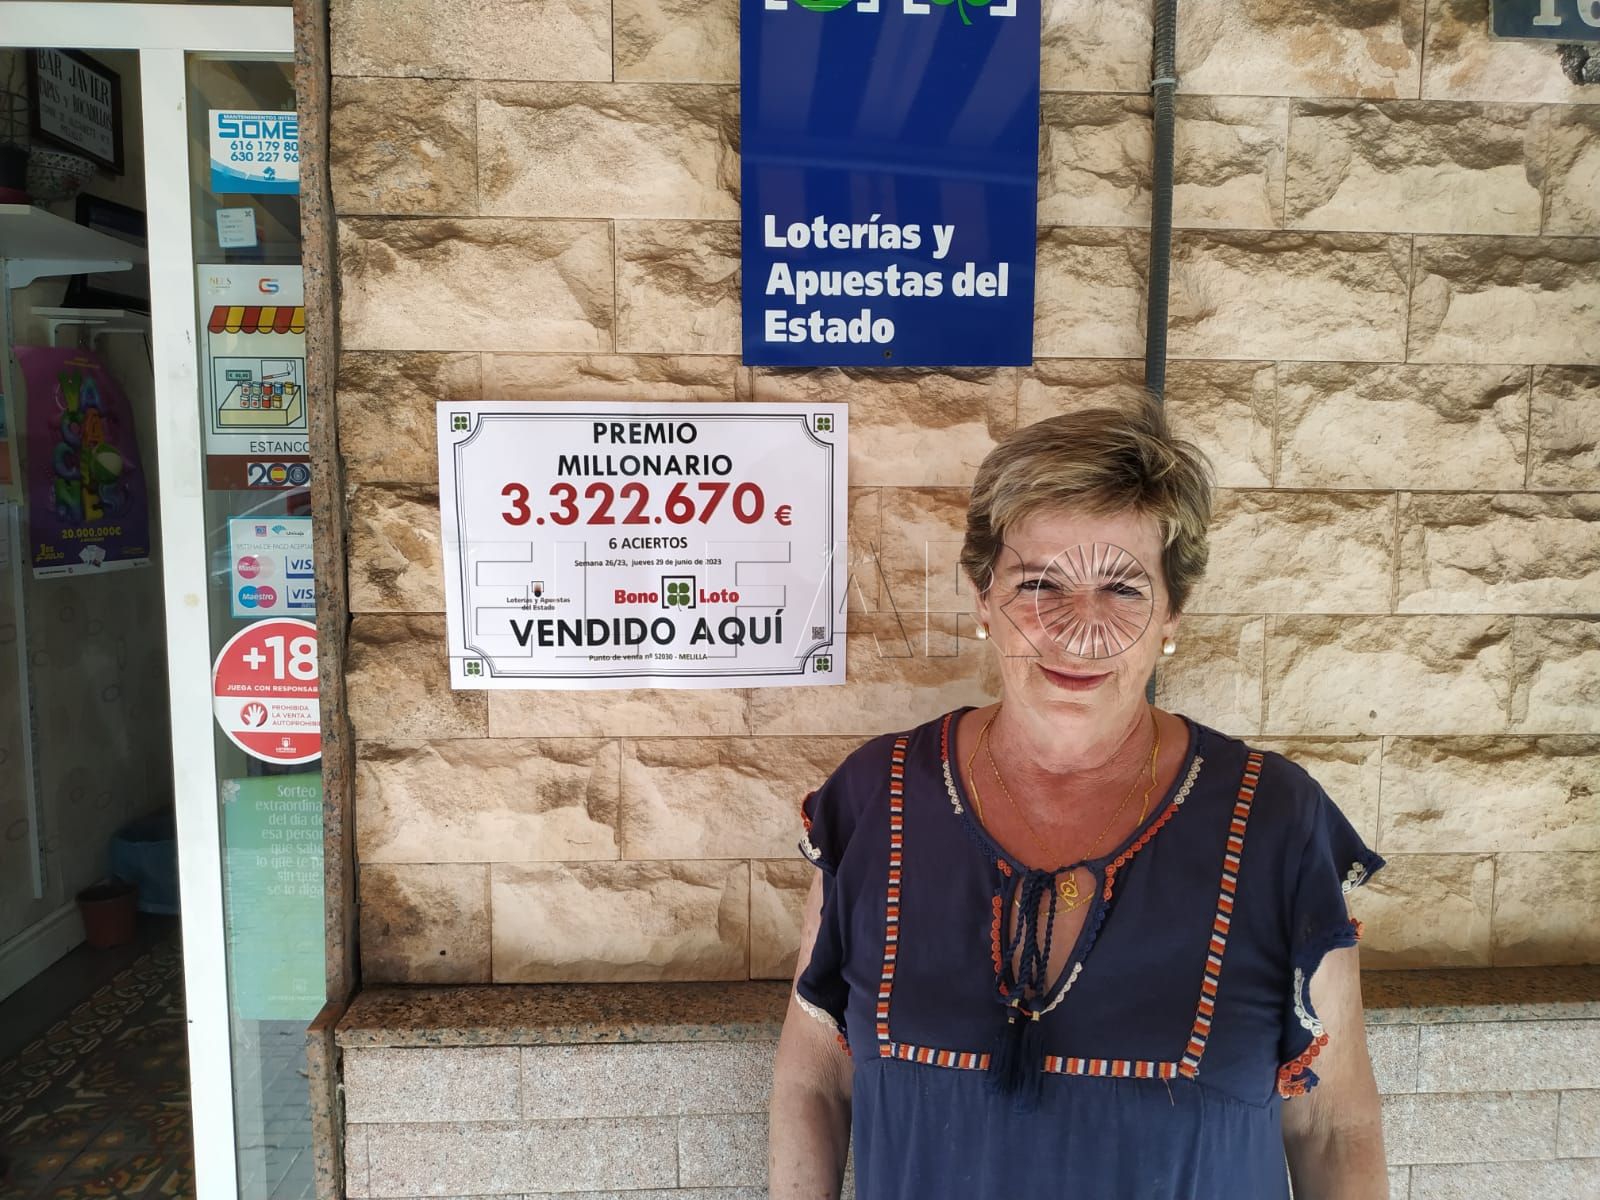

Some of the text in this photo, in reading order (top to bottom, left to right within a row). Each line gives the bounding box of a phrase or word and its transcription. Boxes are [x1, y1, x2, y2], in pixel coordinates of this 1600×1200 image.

[38, 48, 109, 106] BAR JAVIER
[230, 141, 298, 152] 616 179 80
[230, 152, 299, 163] 630 227 96
[764, 214, 955, 260] Loterías y
[765, 262, 1009, 305] Apuestas del
[764, 309, 895, 344] Estado
[593, 422, 698, 444] PREMIO
[557, 454, 733, 476] MILLONARIO
[501, 482, 792, 526] 3.322.670 €
[608, 537, 688, 550] 6 ACIERTOS
[291, 560, 314, 570] VIS
[574, 559, 603, 567] Semana
[605, 559, 628, 567] 26/23,
[631, 559, 654, 567] jueves
[674, 559, 692, 567] junio
[292, 589, 315, 599] VIS
[614, 589, 740, 604] Bono Loto
[509, 609, 784, 647] VENDIDO AQUÍ
[254, 684, 270, 692] CON
[278, 785, 316, 798] Sorteo
[269, 813, 286, 825] del
[262, 829, 282, 840] esa
[271, 843, 292, 855] que
[256, 855, 267, 867] lo
[271, 857, 292, 869] que
